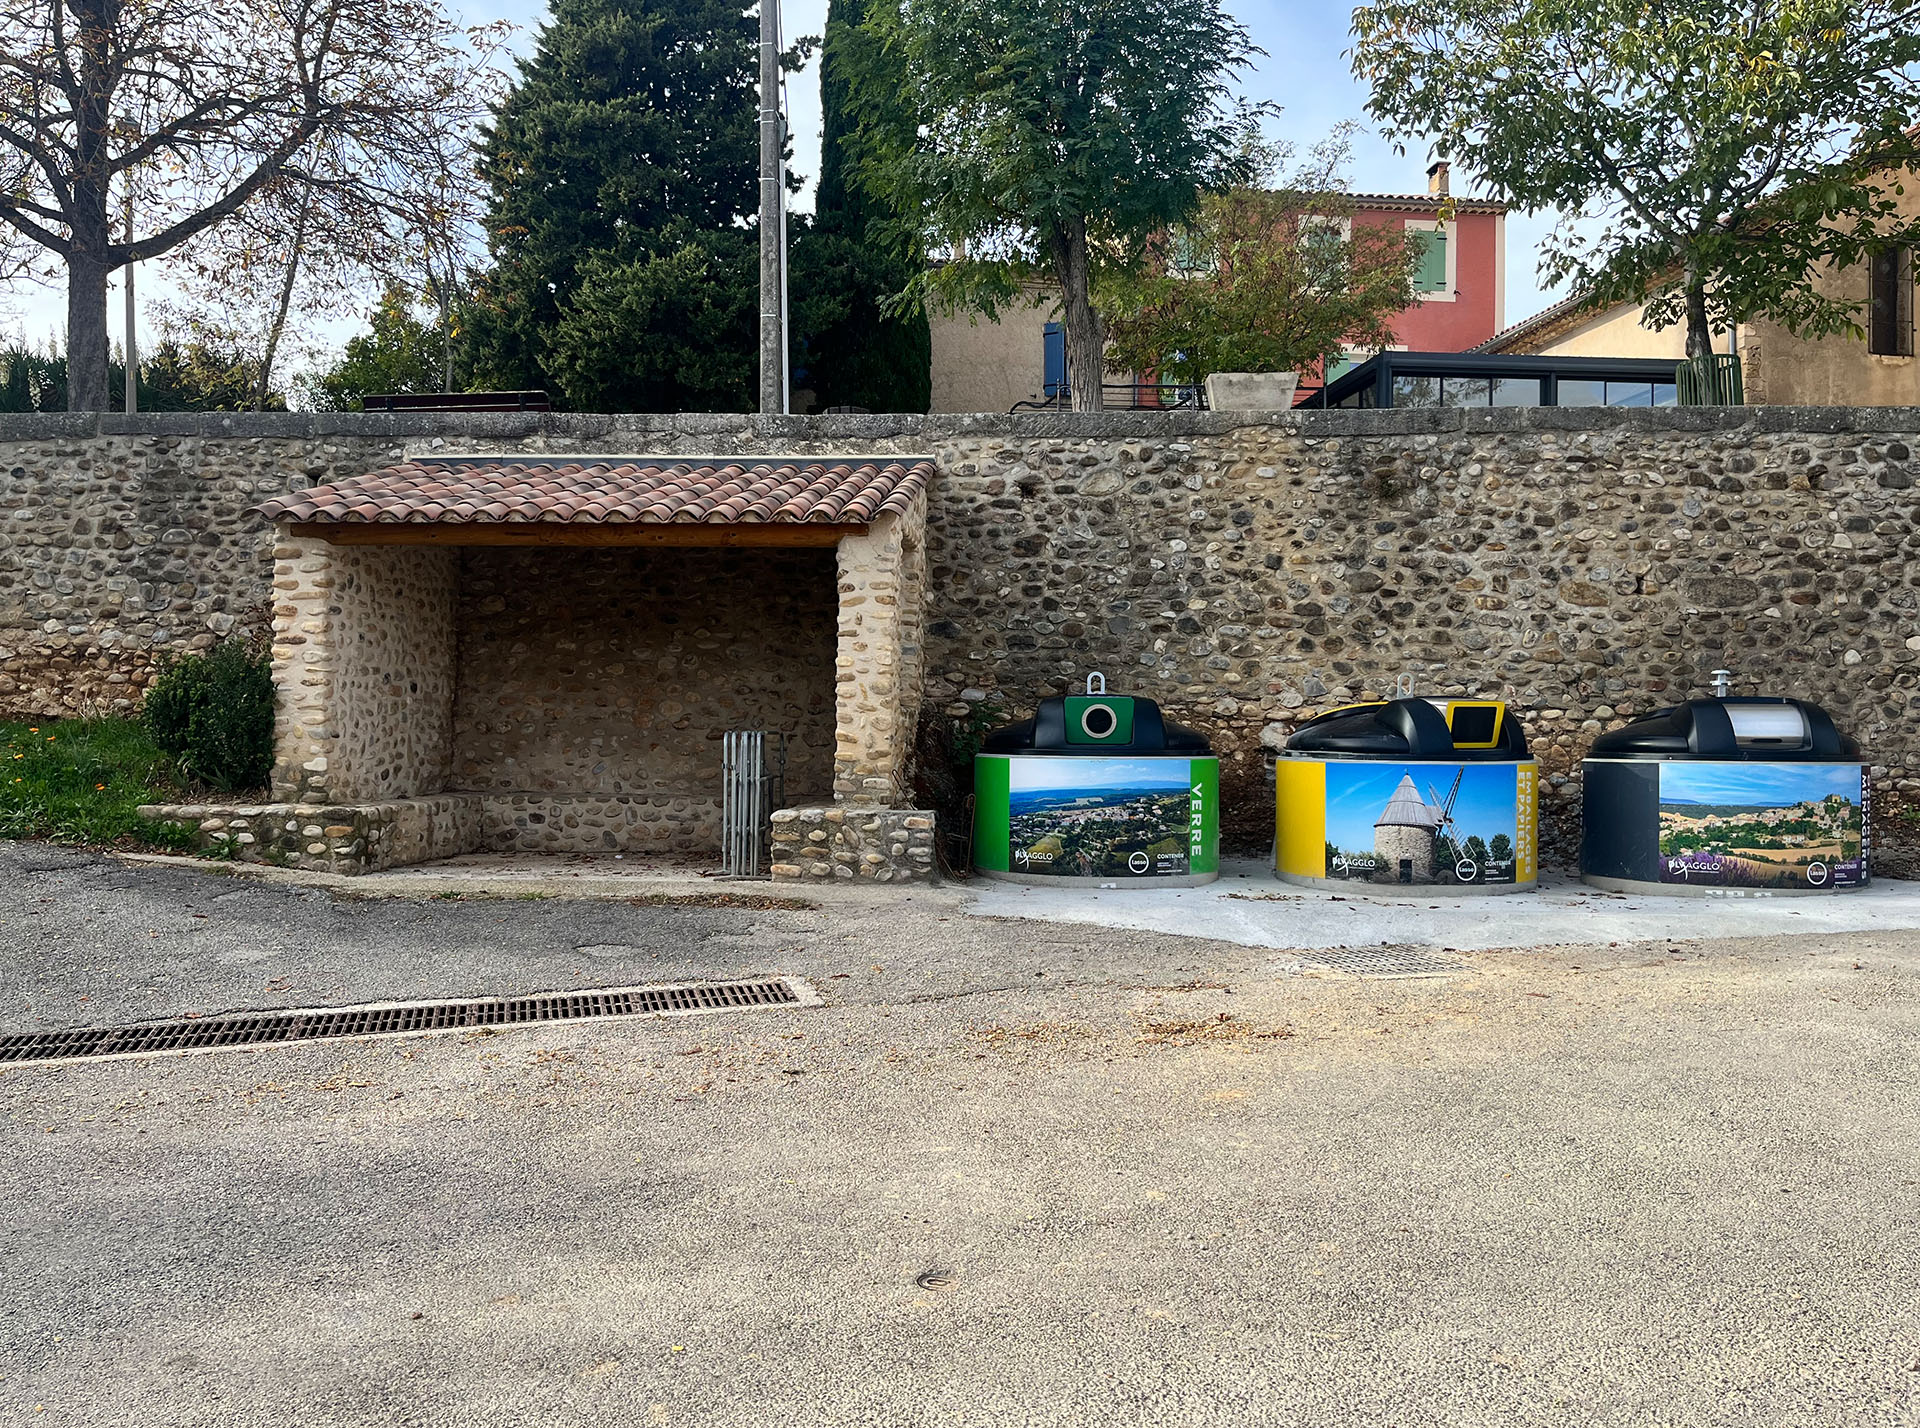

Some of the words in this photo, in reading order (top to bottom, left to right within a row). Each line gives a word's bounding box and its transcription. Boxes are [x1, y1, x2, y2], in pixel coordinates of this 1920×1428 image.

[1518, 771, 1525, 789] ET
[1191, 782, 1202, 857] VERRE
[1517, 795, 1525, 860] PAPIERS
[1525, 771, 1533, 874] EMBALLAGES
